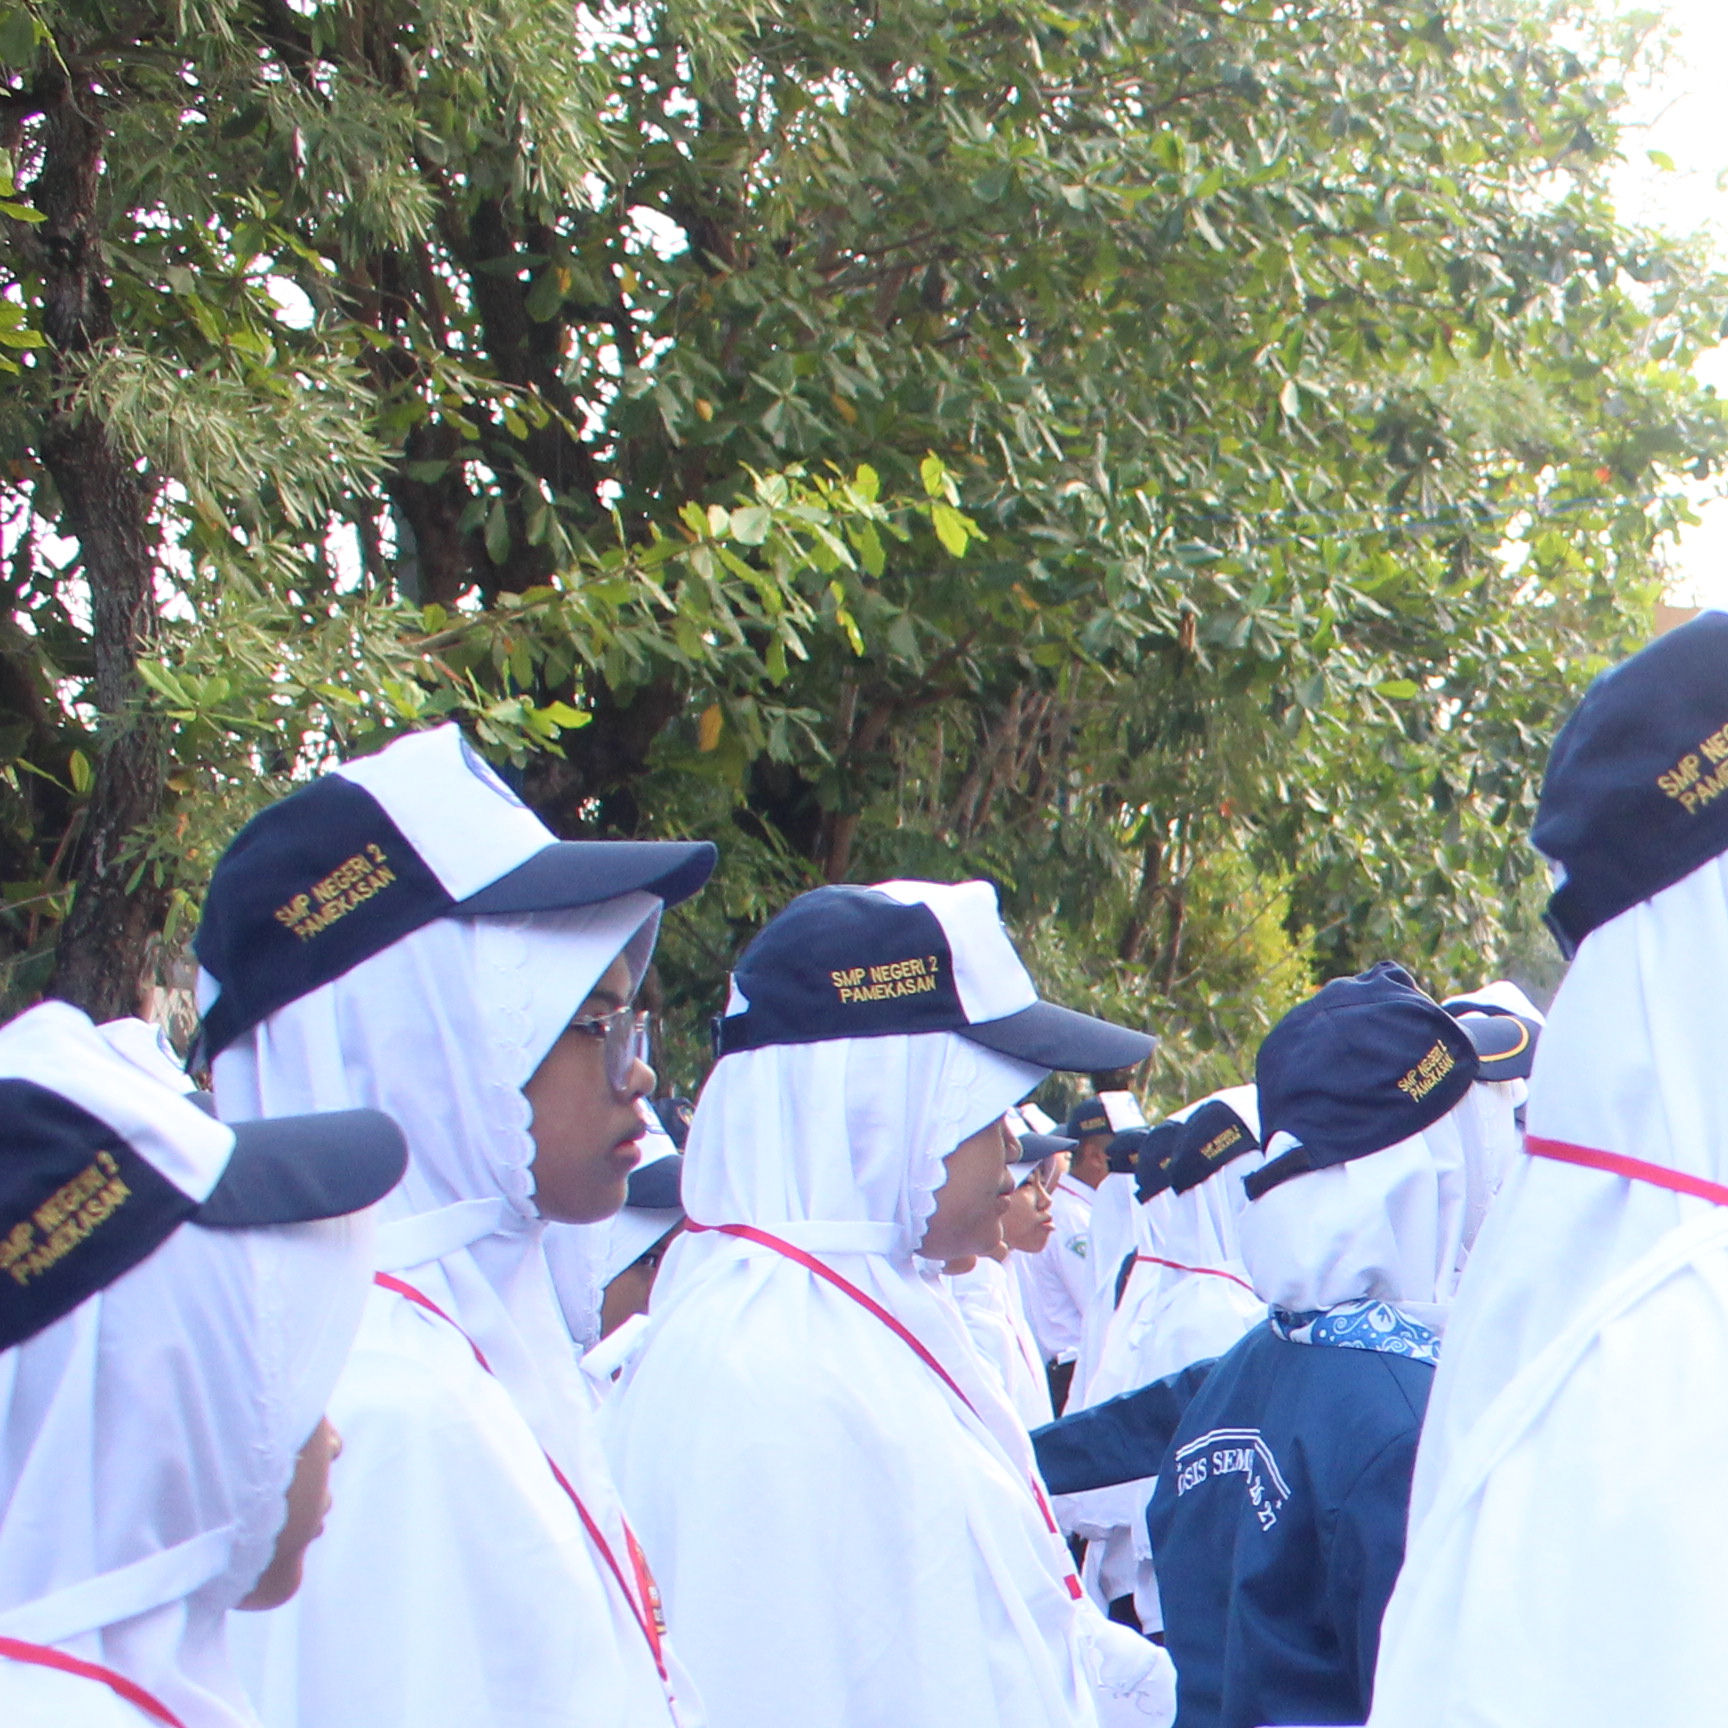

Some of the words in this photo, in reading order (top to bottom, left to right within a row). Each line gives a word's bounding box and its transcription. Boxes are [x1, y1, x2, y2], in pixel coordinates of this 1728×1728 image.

[1657, 753, 1700, 797] SMP
[273, 894, 310, 927] SMP
[311, 854, 374, 902] NEGERI
[367, 843, 388, 863] 2
[292, 865, 397, 943] PAMEKASAN
[831, 968, 866, 988] SMP
[870, 958, 926, 983] NEGERI
[929, 955, 939, 972] 2
[839, 975, 936, 1004] PAMEKASAN
[10, 1177, 132, 1286] PAMEKASAN
